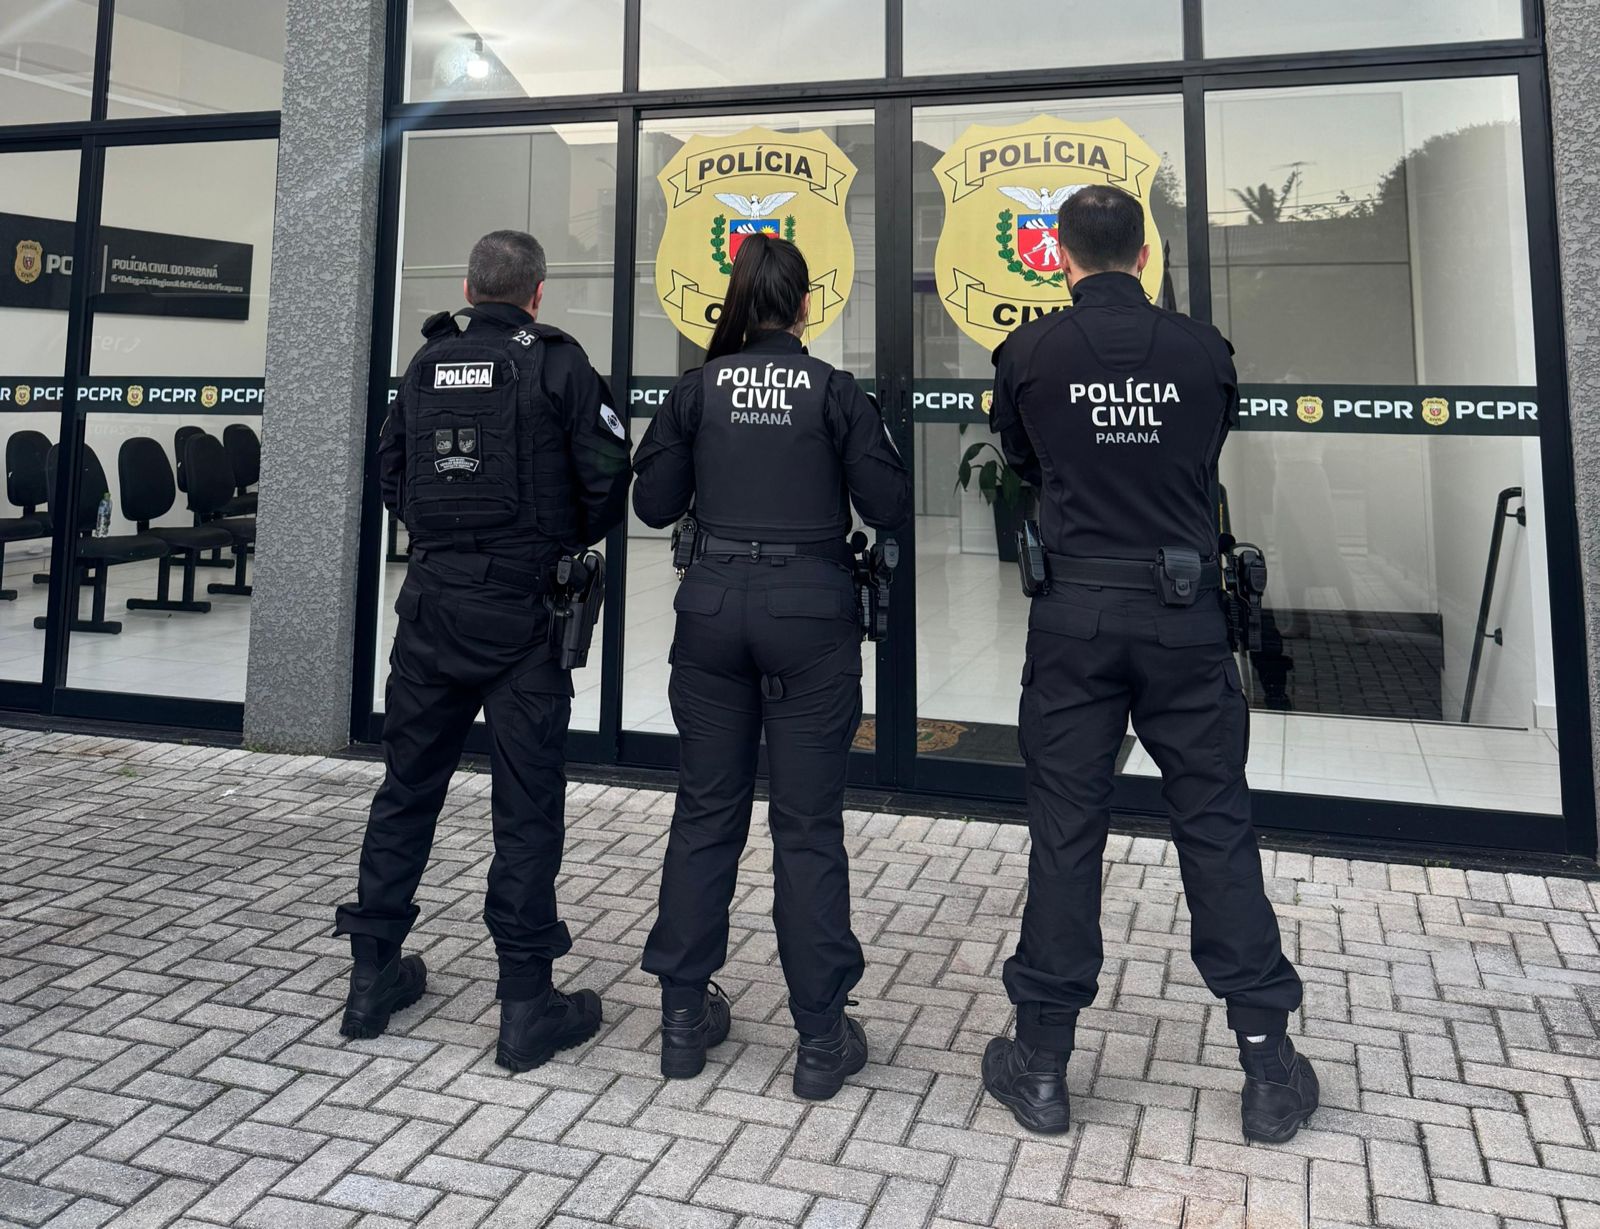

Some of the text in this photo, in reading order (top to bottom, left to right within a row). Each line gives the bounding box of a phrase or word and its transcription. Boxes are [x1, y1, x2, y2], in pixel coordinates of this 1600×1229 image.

[699, 146, 813, 180] POLÍCIA
[979, 136, 1110, 172] POLÍCIA
[45, 254, 73, 275] PC
[112, 255, 218, 278] POLÍCIA CIVIL DO PARANÁ
[512, 330, 535, 346] 25
[437, 366, 490, 386] POLÍCIA
[716, 362, 811, 389] POLÍCIA
[77, 387, 122, 401] PCPR
[149, 388, 196, 402] PCPR
[731, 388, 793, 410] CIVIL
[913, 392, 974, 409] PCPR
[1069, 377, 1181, 404] POLÍCIA
[730, 410, 793, 426] PARANÁ
[1092, 406, 1162, 426] CIVIL
[1333, 399, 1413, 419] PCPR
[1455, 401, 1538, 420] PCPR
[1095, 429, 1160, 444] PARANÁ
